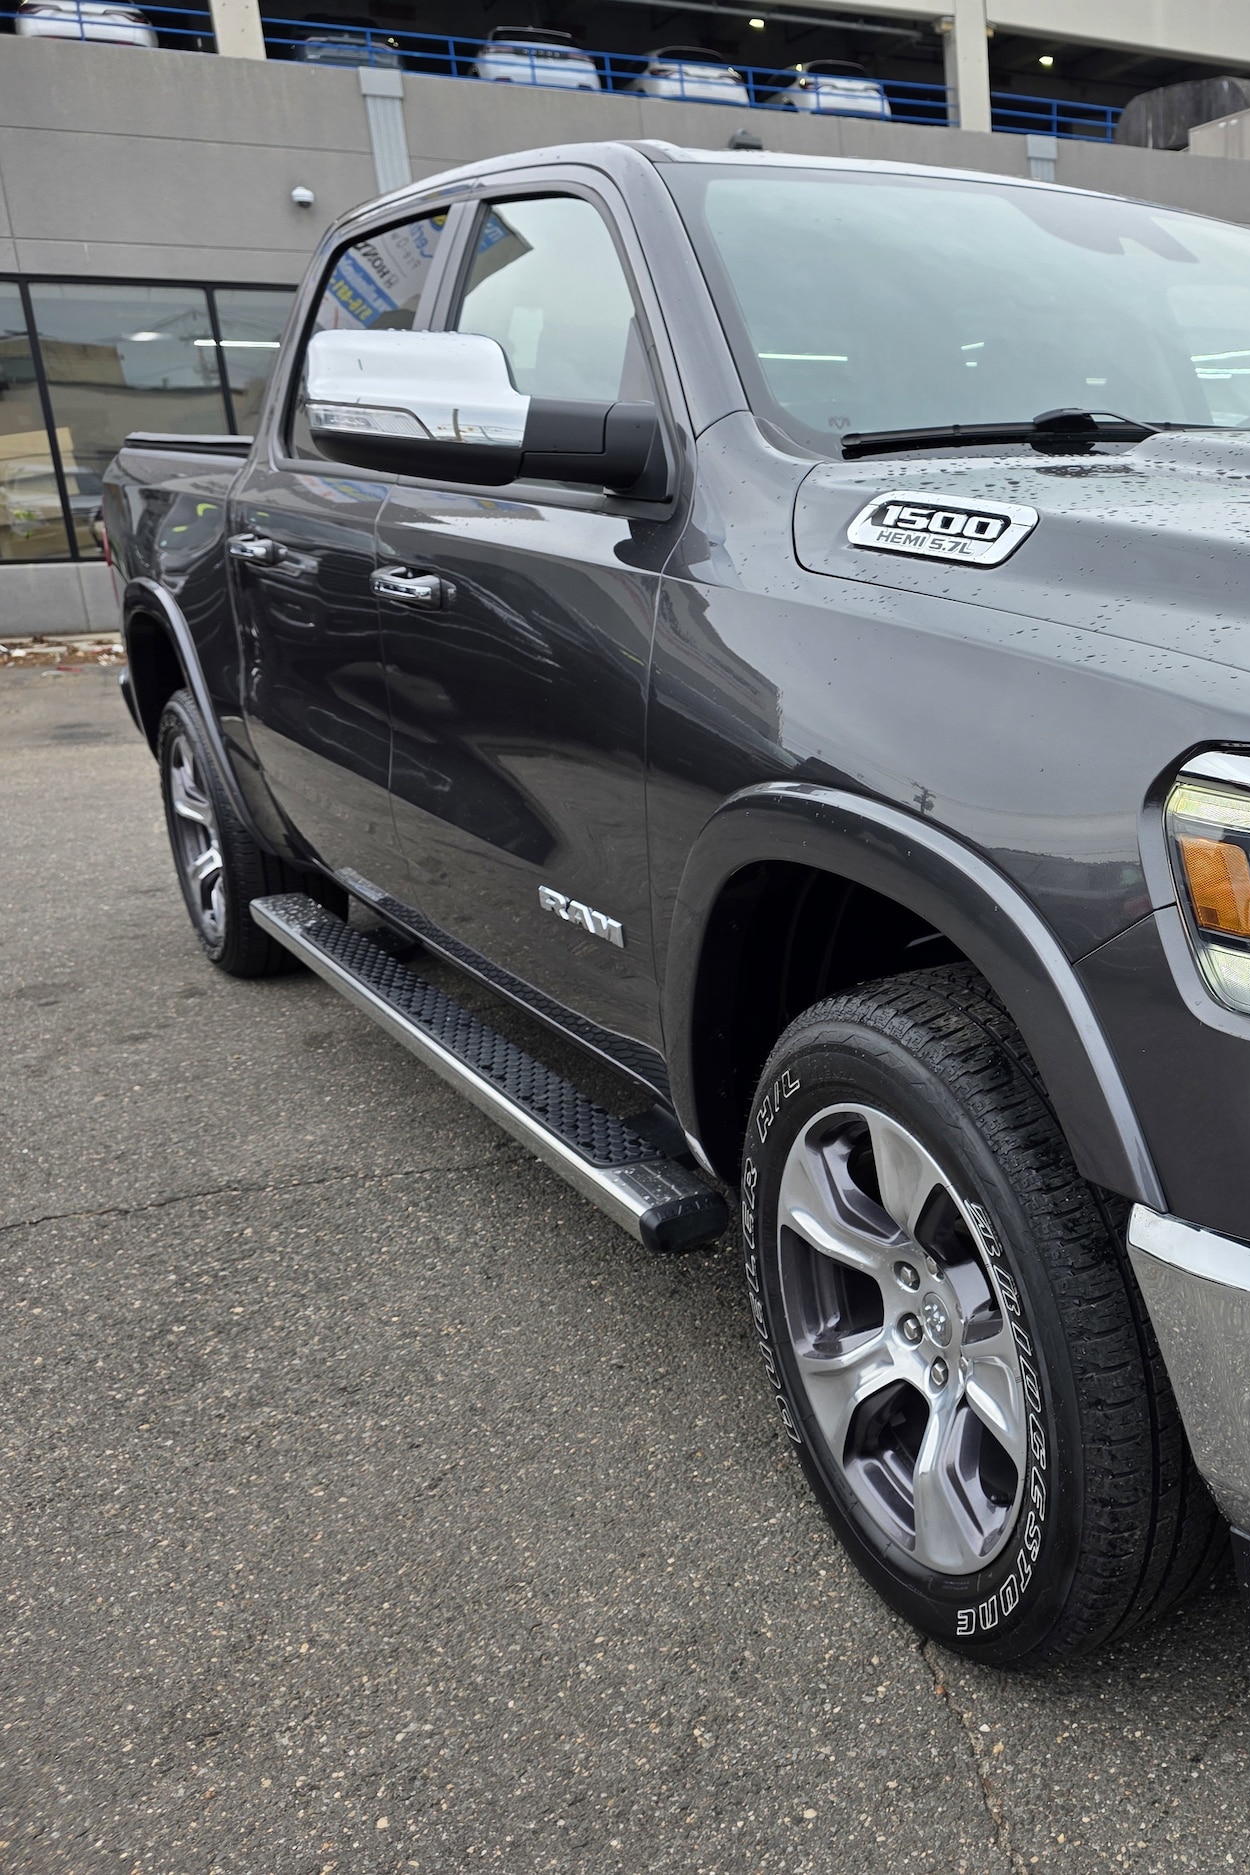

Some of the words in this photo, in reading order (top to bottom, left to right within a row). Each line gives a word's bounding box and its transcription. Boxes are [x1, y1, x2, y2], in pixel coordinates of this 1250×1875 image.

[876, 529, 927, 549] HEMI
[928, 538, 975, 556] 5.7L
[883, 504, 1005, 540] 1500
[538, 884, 625, 949] RAM
[742, 1157, 802, 1444] DUELER
[955, 1198, 1048, 1637] BRIDGESTONE
